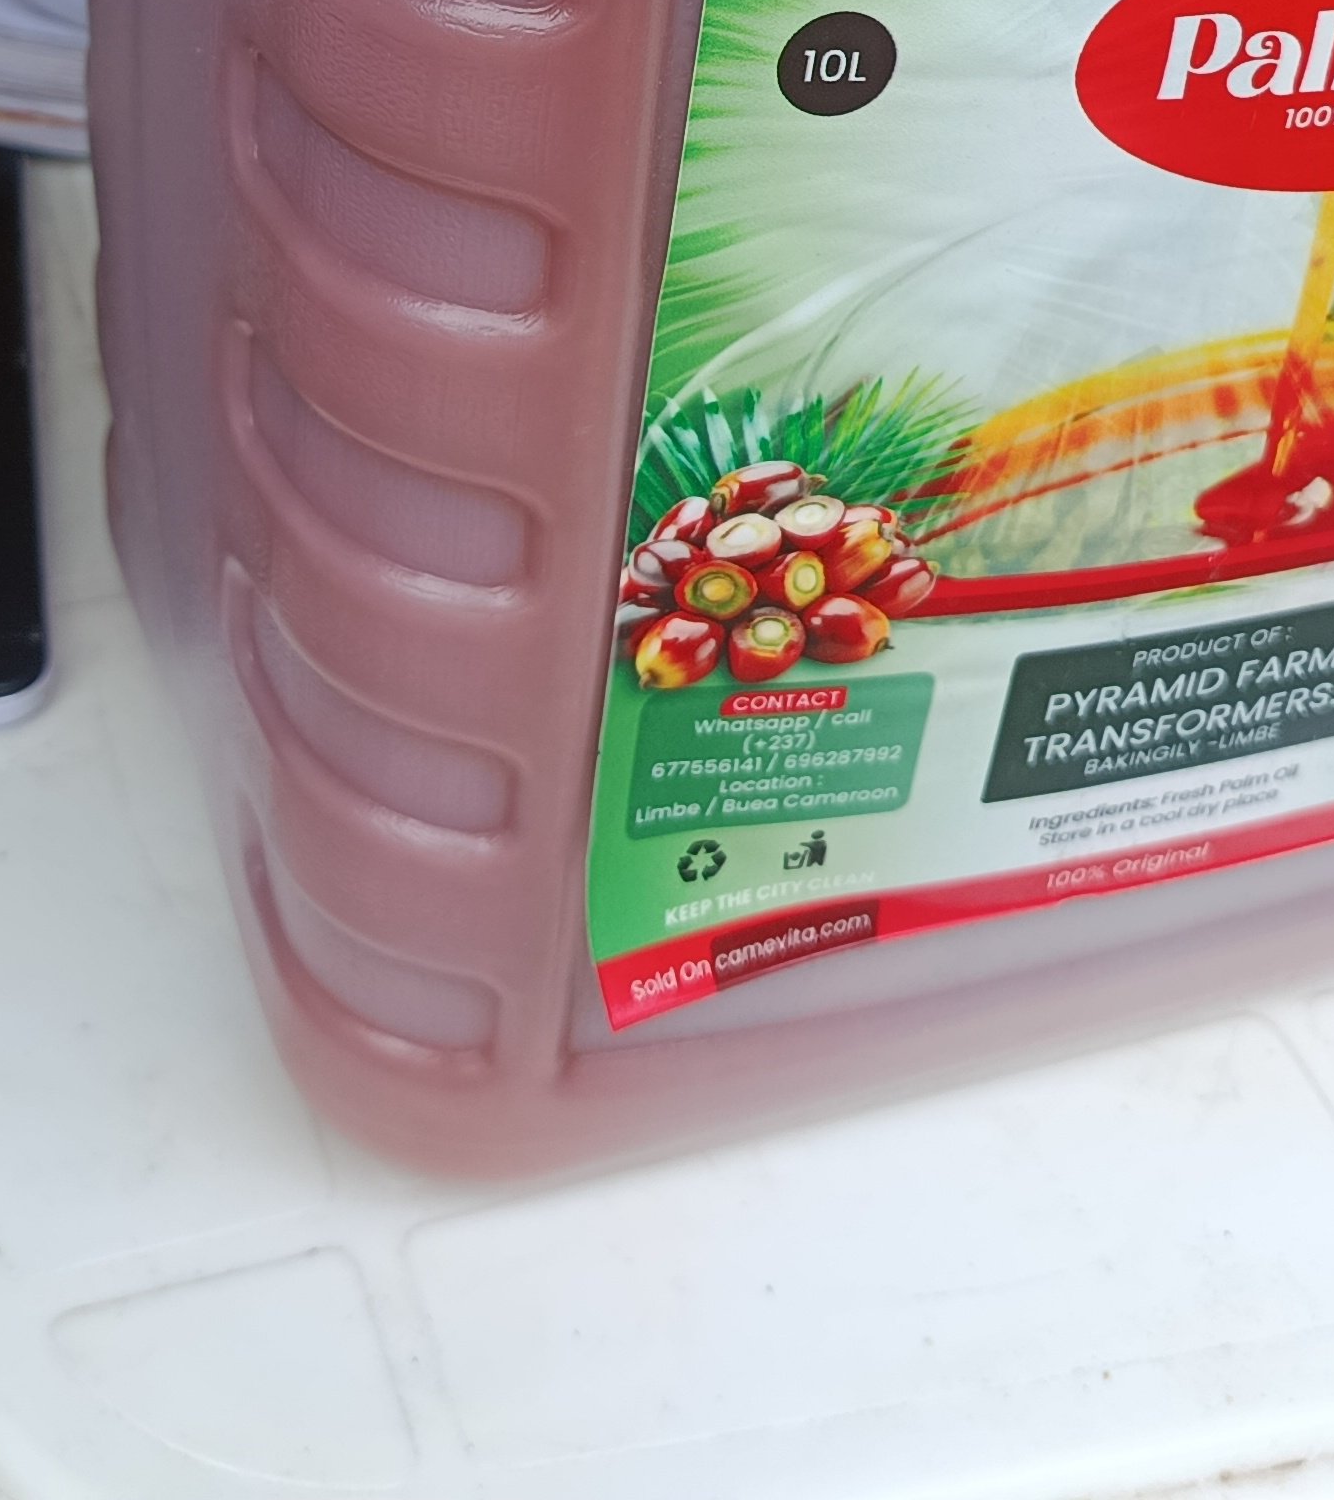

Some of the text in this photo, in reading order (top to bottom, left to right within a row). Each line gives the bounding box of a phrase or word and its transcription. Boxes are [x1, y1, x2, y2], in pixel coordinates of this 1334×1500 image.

[801, 47, 867, 85] 10L
[1132, 631, 1246, 668] PRODUCT
[732, 690, 841, 712] CONTACT
[1044, 666, 1229, 725] PYRAMID
[694, 715, 810, 735] Whatsapp
[831, 708, 872, 727] call
[742, 729, 816, 755] (+237)
[650, 756, 762, 779] 677556141
[784, 744, 903, 770] 696287992
[719, 774, 812, 794] Location
[1028, 763, 1300, 831] Ingredients: Fresh Palm Oil
[635, 801, 701, 824] Limbe
[722, 796, 779, 814] Buea
[783, 785, 898, 809] Cameroon
[1038, 787, 1279, 847] Store in a cool dry place
[1046, 841, 1210, 890] 100% Original
[665, 870, 876, 927] KEEP THE CITY CLEAN
[630, 912, 873, 1001] Sold On camevita.com
